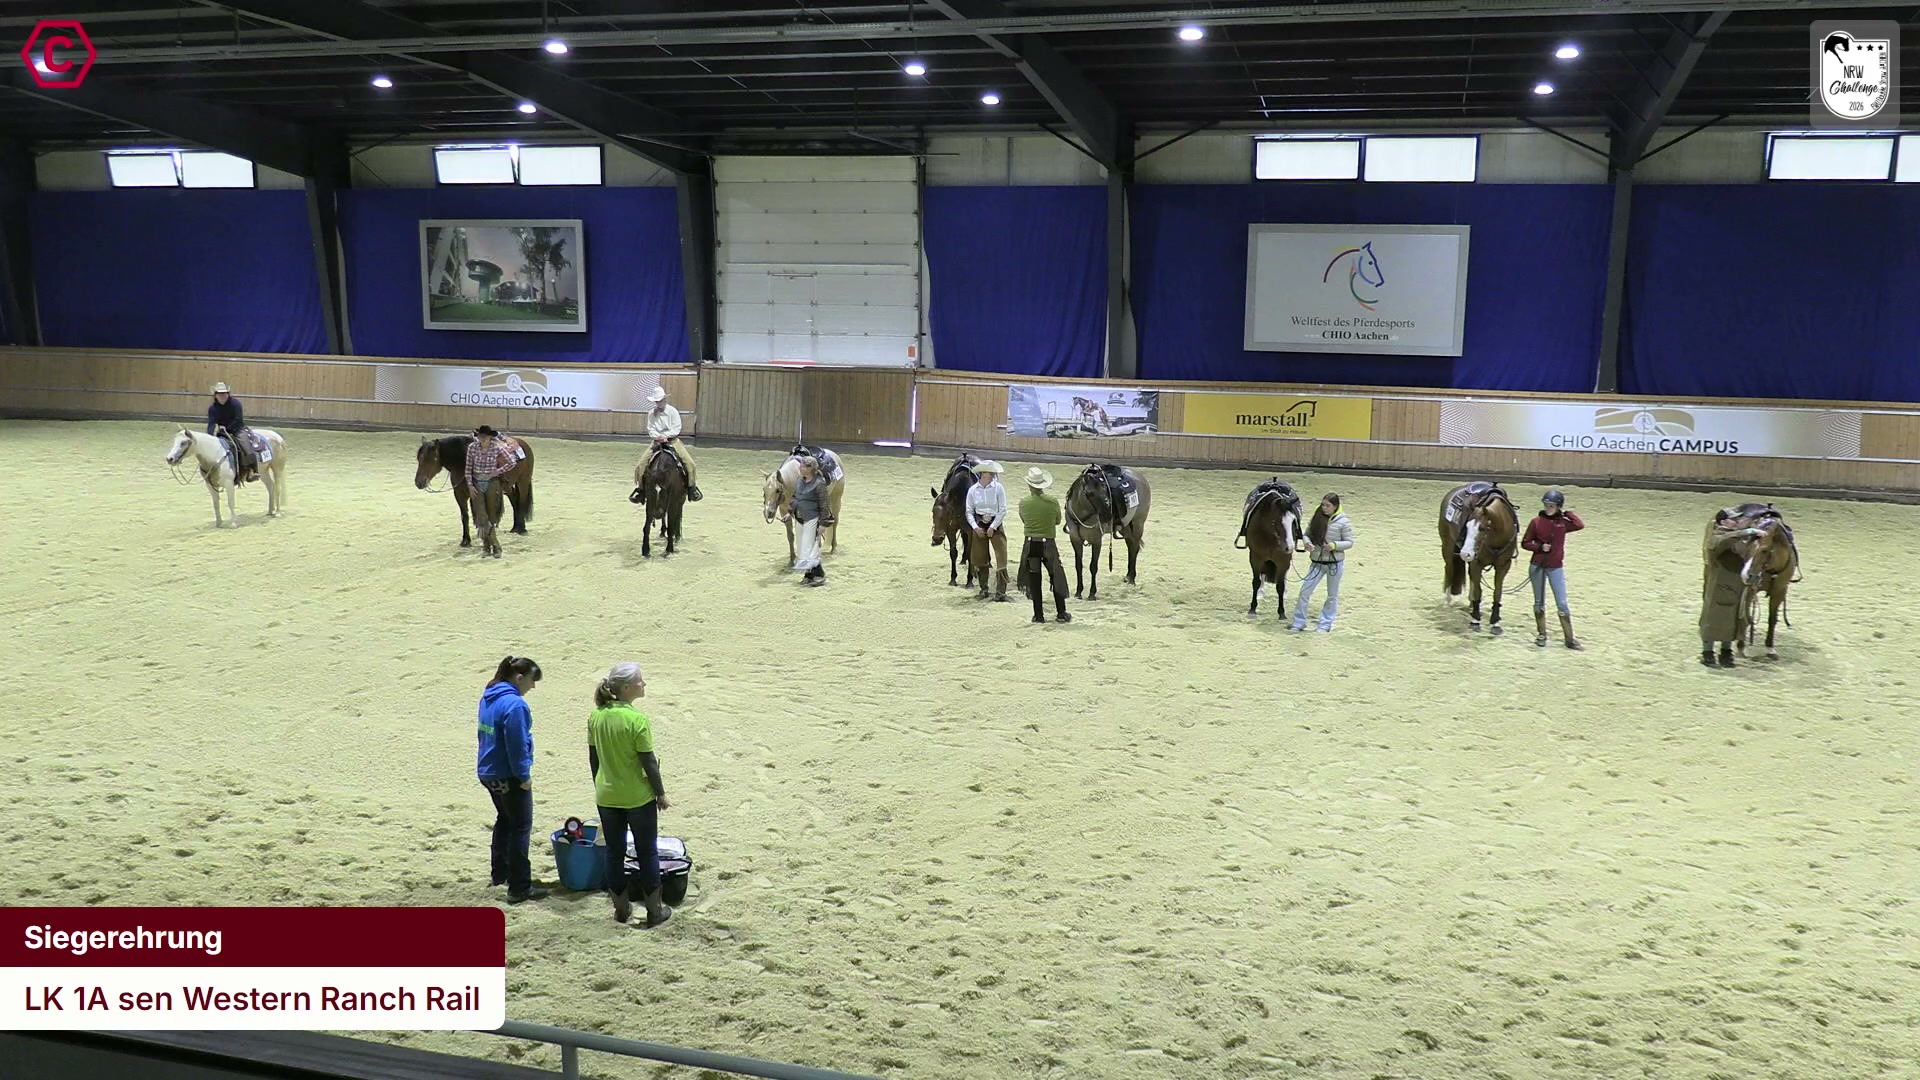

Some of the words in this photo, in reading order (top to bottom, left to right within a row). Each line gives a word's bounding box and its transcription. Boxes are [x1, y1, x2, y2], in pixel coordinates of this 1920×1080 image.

[1291, 315, 1331, 327] Weltfest
[1333, 317, 1350, 327] des
[1353, 317, 1415, 330] Pferdesports
[1322, 330, 1351, 340] CHIO
[1354, 332, 1389, 341] Aachen
[450, 392, 480, 404] CHIO
[482, 394, 521, 406] Aachen
[523, 395, 577, 408] CAMPUS
[1236, 412, 1307, 427] marstall
[1550, 434, 1594, 449] CHIO
[1597, 436, 1655, 451] Aachen
[1659, 438, 1739, 454] CAMPUS
